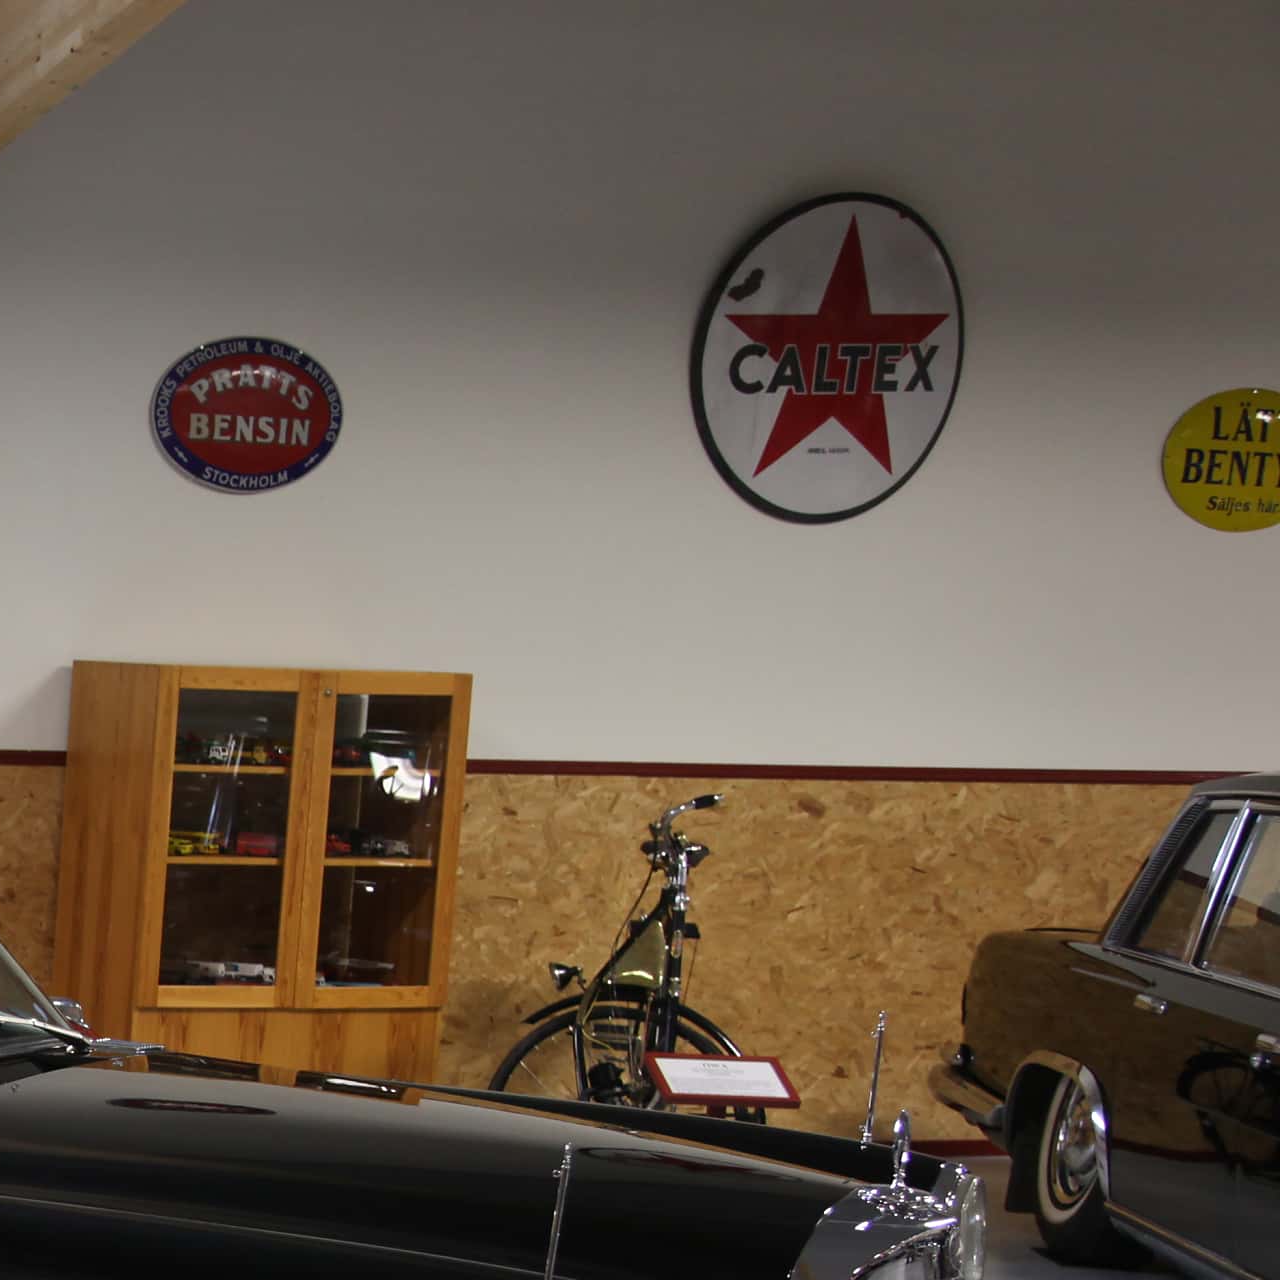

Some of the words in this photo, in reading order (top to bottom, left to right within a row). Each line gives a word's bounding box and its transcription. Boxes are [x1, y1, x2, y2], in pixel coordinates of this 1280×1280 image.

[190, 364, 314, 411] PRATTS
[728, 343, 939, 395] CALTEX
[156, 379, 177, 438] KROOKS
[176, 340, 249, 377] PETROLEUM
[271, 343, 300, 365] OLJE
[304, 358, 341, 442] AKTIEBOLAG
[188, 413, 312, 447] BENSIN
[1211, 401, 1280, 443] LÄT
[202, 466, 289, 489] STOCKHOLM
[1181, 447, 1280, 488] BENT
[1206, 496, 1251, 516] Säljes
